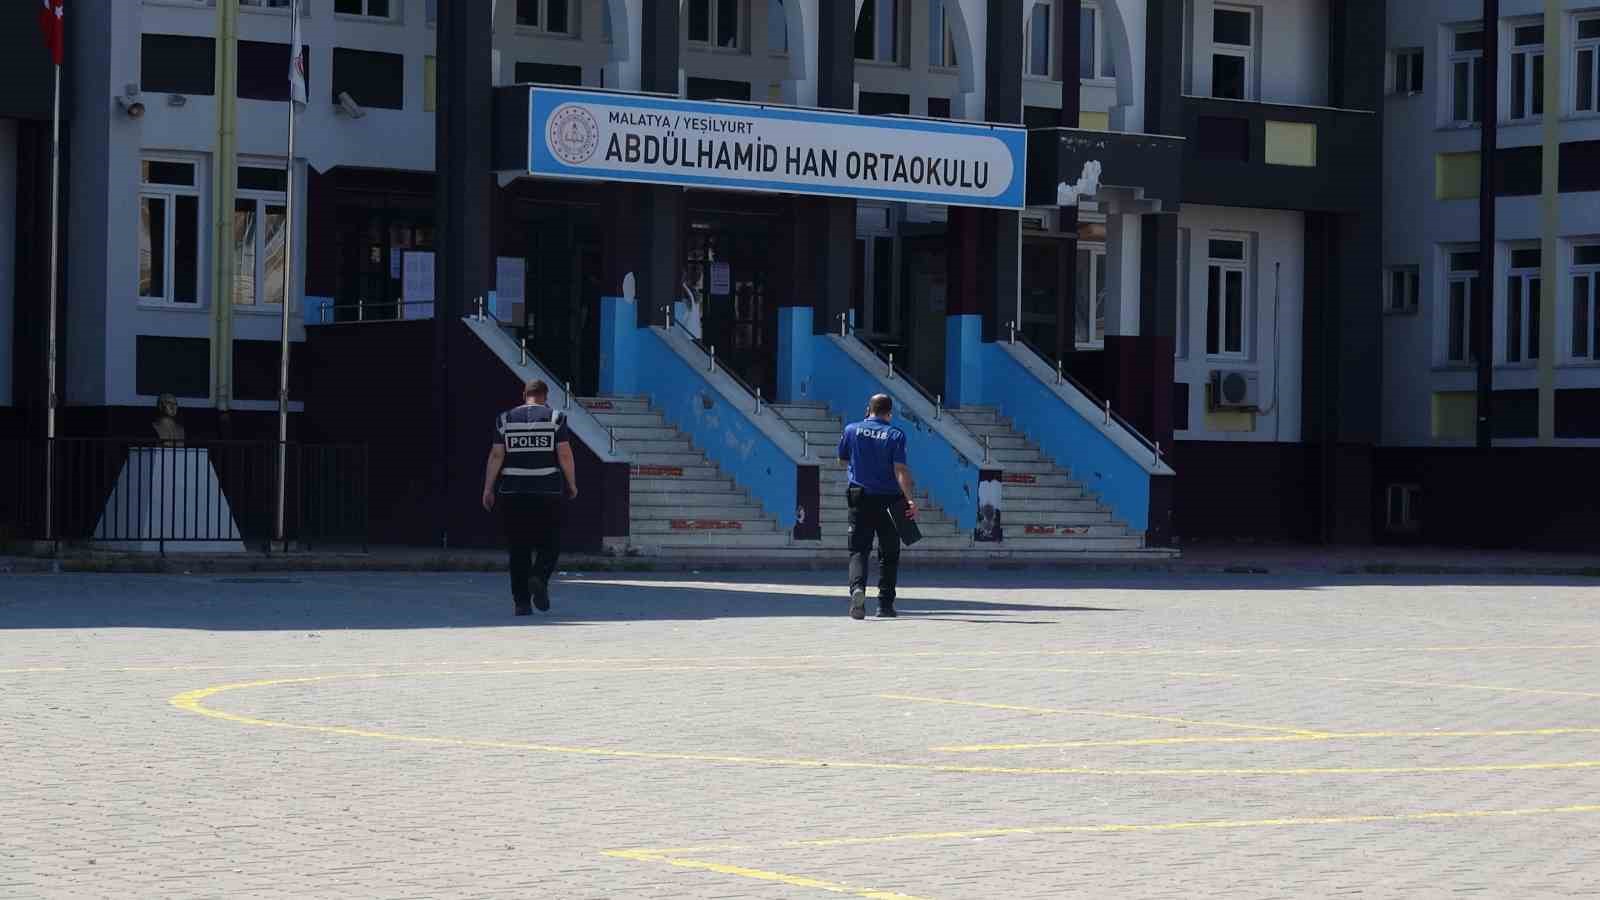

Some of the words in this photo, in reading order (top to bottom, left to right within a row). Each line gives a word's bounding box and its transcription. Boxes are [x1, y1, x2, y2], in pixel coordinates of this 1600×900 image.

[609, 111, 671, 128] MALATYA
[683, 116, 753, 134] YEŞİLYURT
[605, 131, 778, 173] ABDÜLHAMİD
[785, 145, 838, 178] HAN
[846, 151, 989, 189] ORTAOKULU
